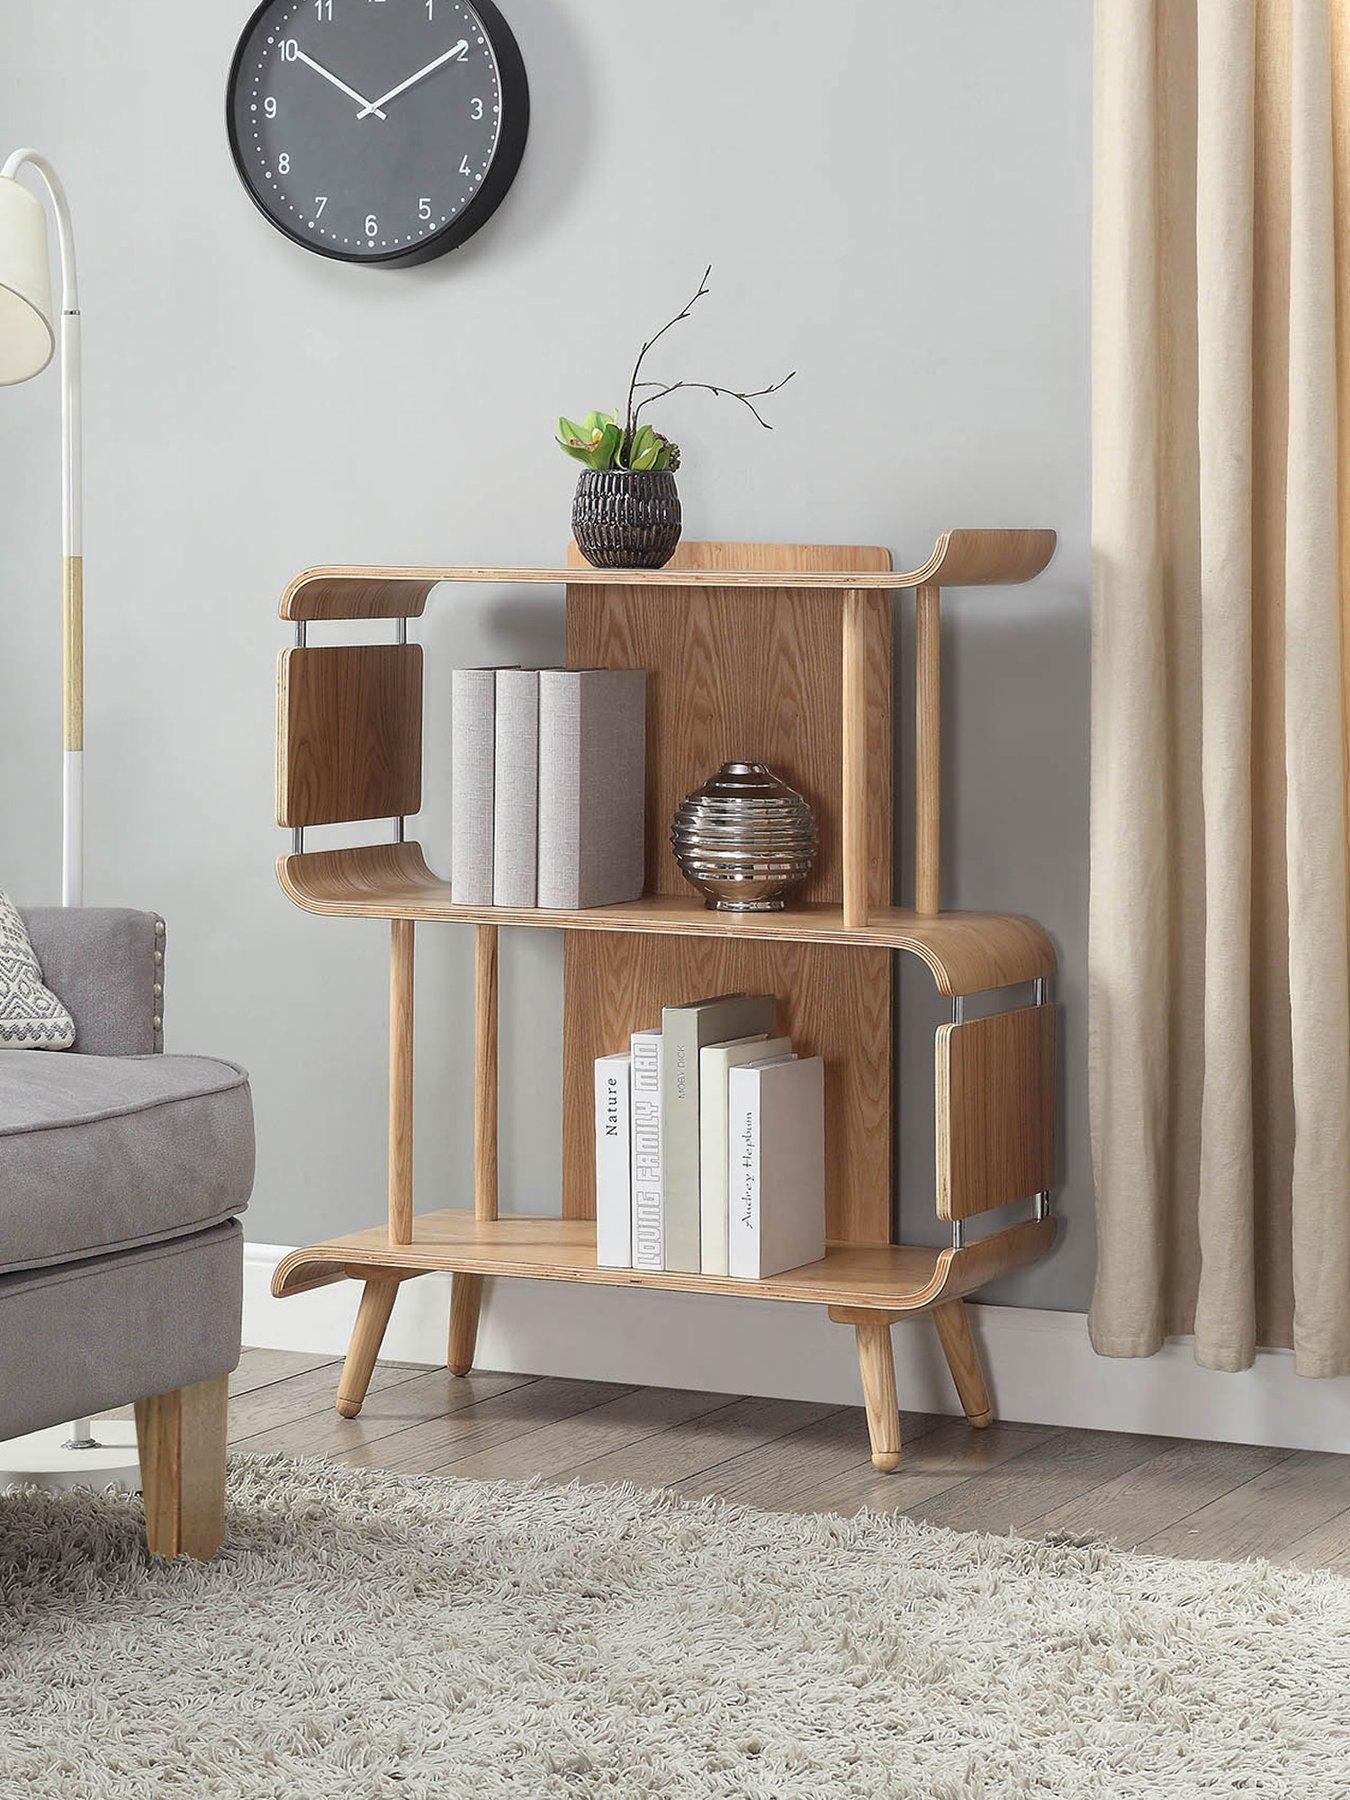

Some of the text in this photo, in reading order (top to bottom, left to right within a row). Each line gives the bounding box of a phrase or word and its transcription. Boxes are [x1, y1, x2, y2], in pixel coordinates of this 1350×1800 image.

[314, 0, 333, 21] 11
[425, 0, 434, 21] 1
[277, 39, 299, 62] 10
[456, 40, 470, 62] 2
[263, 96, 277, 119] 9
[470, 97, 483, 120] 3
[278, 152, 291, 175] 8
[458, 154, 471, 177] 4
[315, 196, 328, 218] 7
[418, 198, 431, 220] 5
[364, 214, 378, 237] 6
[677, 1044, 687, 1100] MOBY DICK
[605, 1077, 618, 1136] Nature
[634, 1042, 662, 1266] LOVING FAMILY MAN
[741, 1112, 755, 1230] Audrey Hepburn
